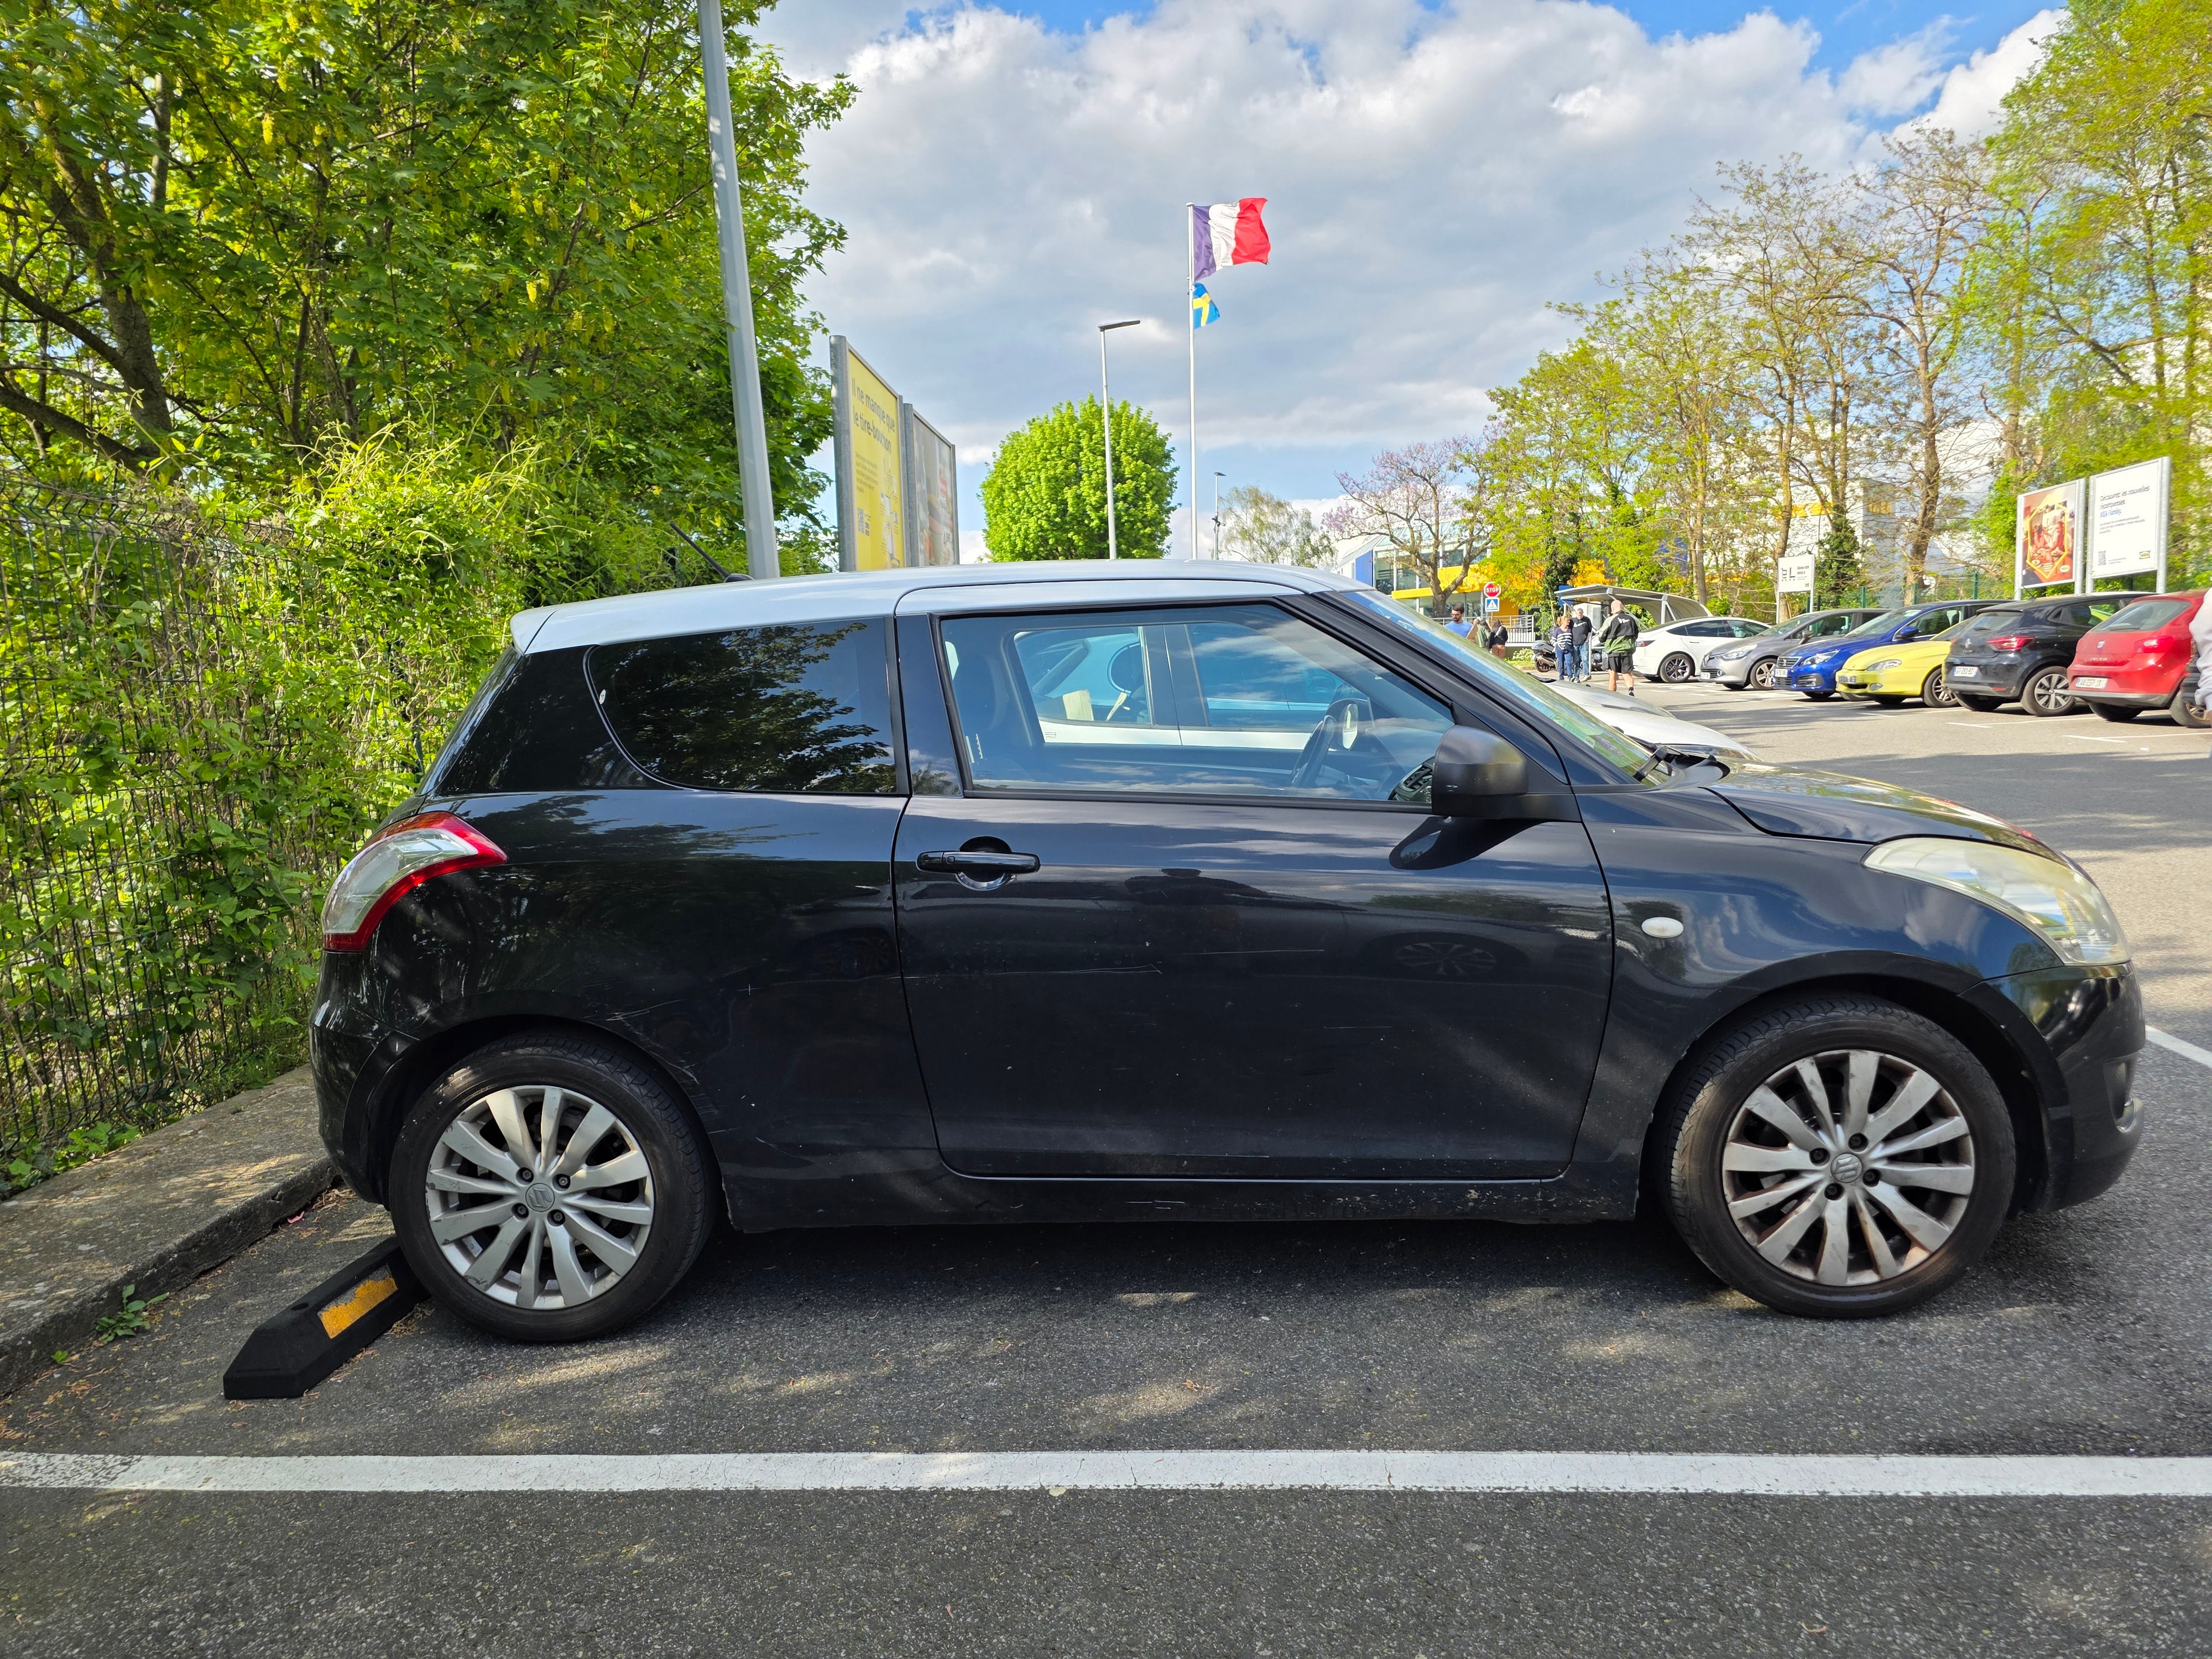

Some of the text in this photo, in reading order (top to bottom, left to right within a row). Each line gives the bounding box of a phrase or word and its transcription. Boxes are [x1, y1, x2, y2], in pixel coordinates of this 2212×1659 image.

[853, 405, 891, 453] le tire-bouchon
[857, 386, 864, 404] ne
[865, 393, 885, 424] manque
[886, 414, 895, 432] que
